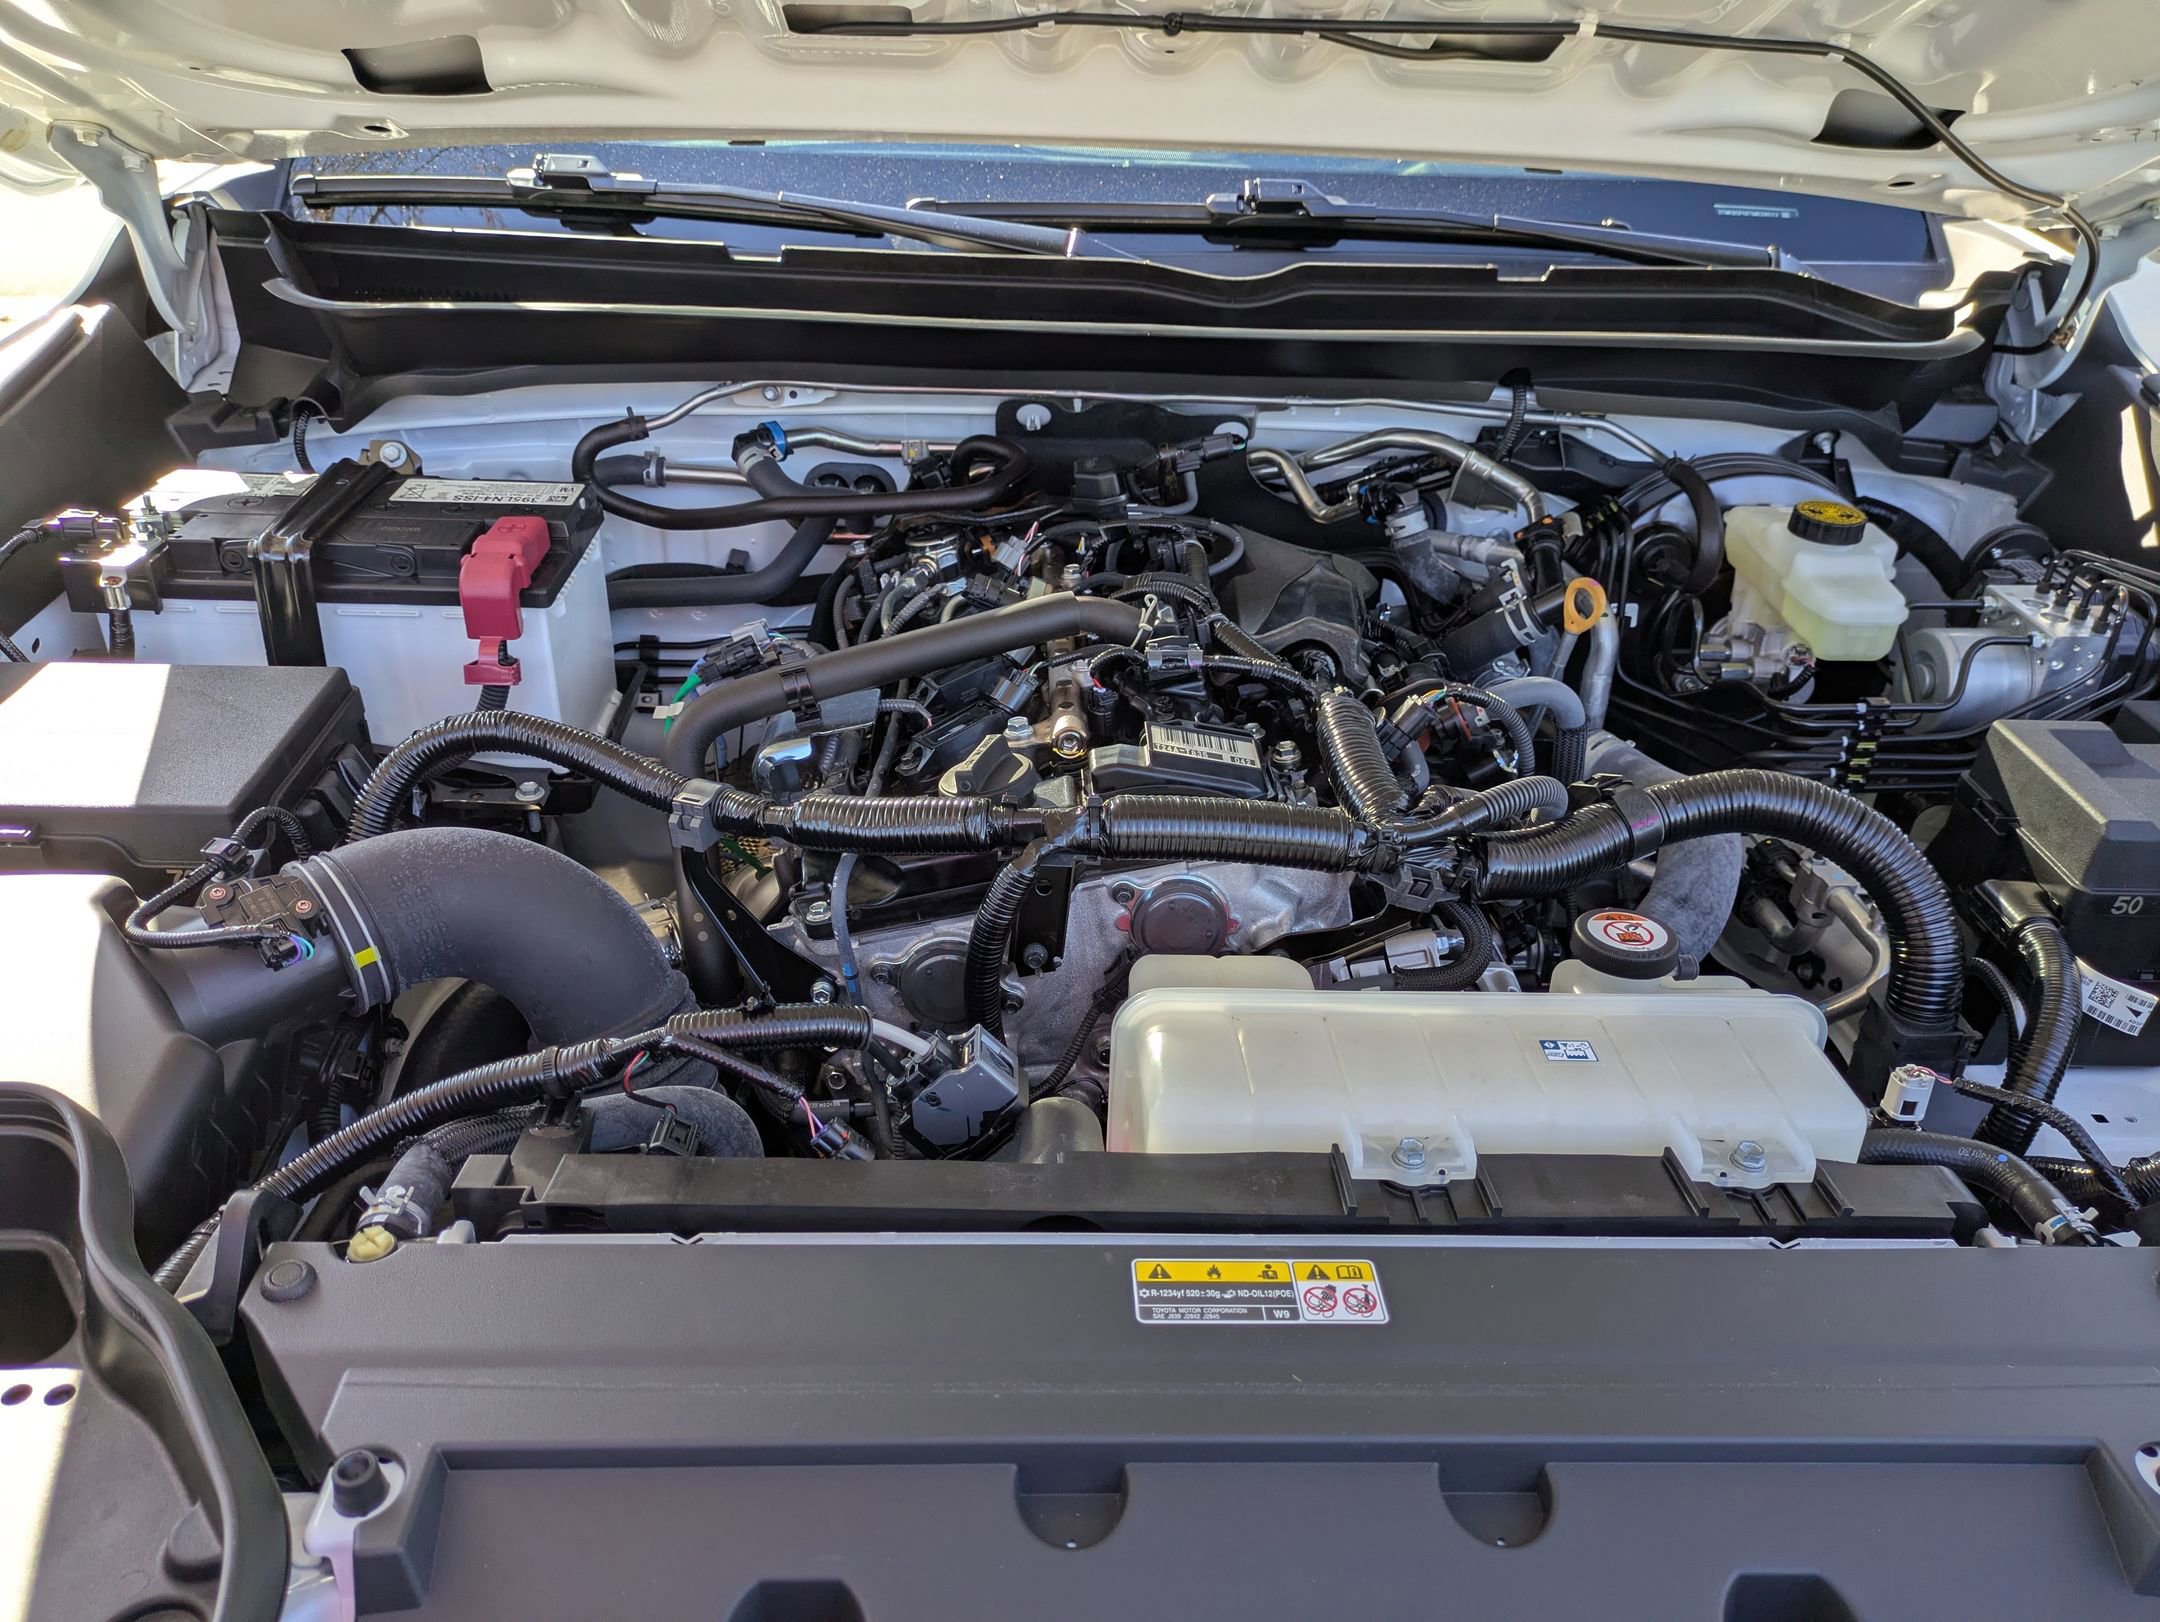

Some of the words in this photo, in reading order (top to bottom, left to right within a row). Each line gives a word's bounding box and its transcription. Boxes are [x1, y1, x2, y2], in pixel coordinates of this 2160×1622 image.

[453, 494, 538, 503] 395LN4-ISS
[1234, 757, 1252, 766] 042
[2111, 896, 2144, 915] 50
[1151, 1288, 1184, 1299] R-1234yf
[1186, 1288, 1221, 1299] 520±30g
[1237, 1288, 1295, 1299] ND-OIL12(POE)
[1273, 1309, 1290, 1319] W9
